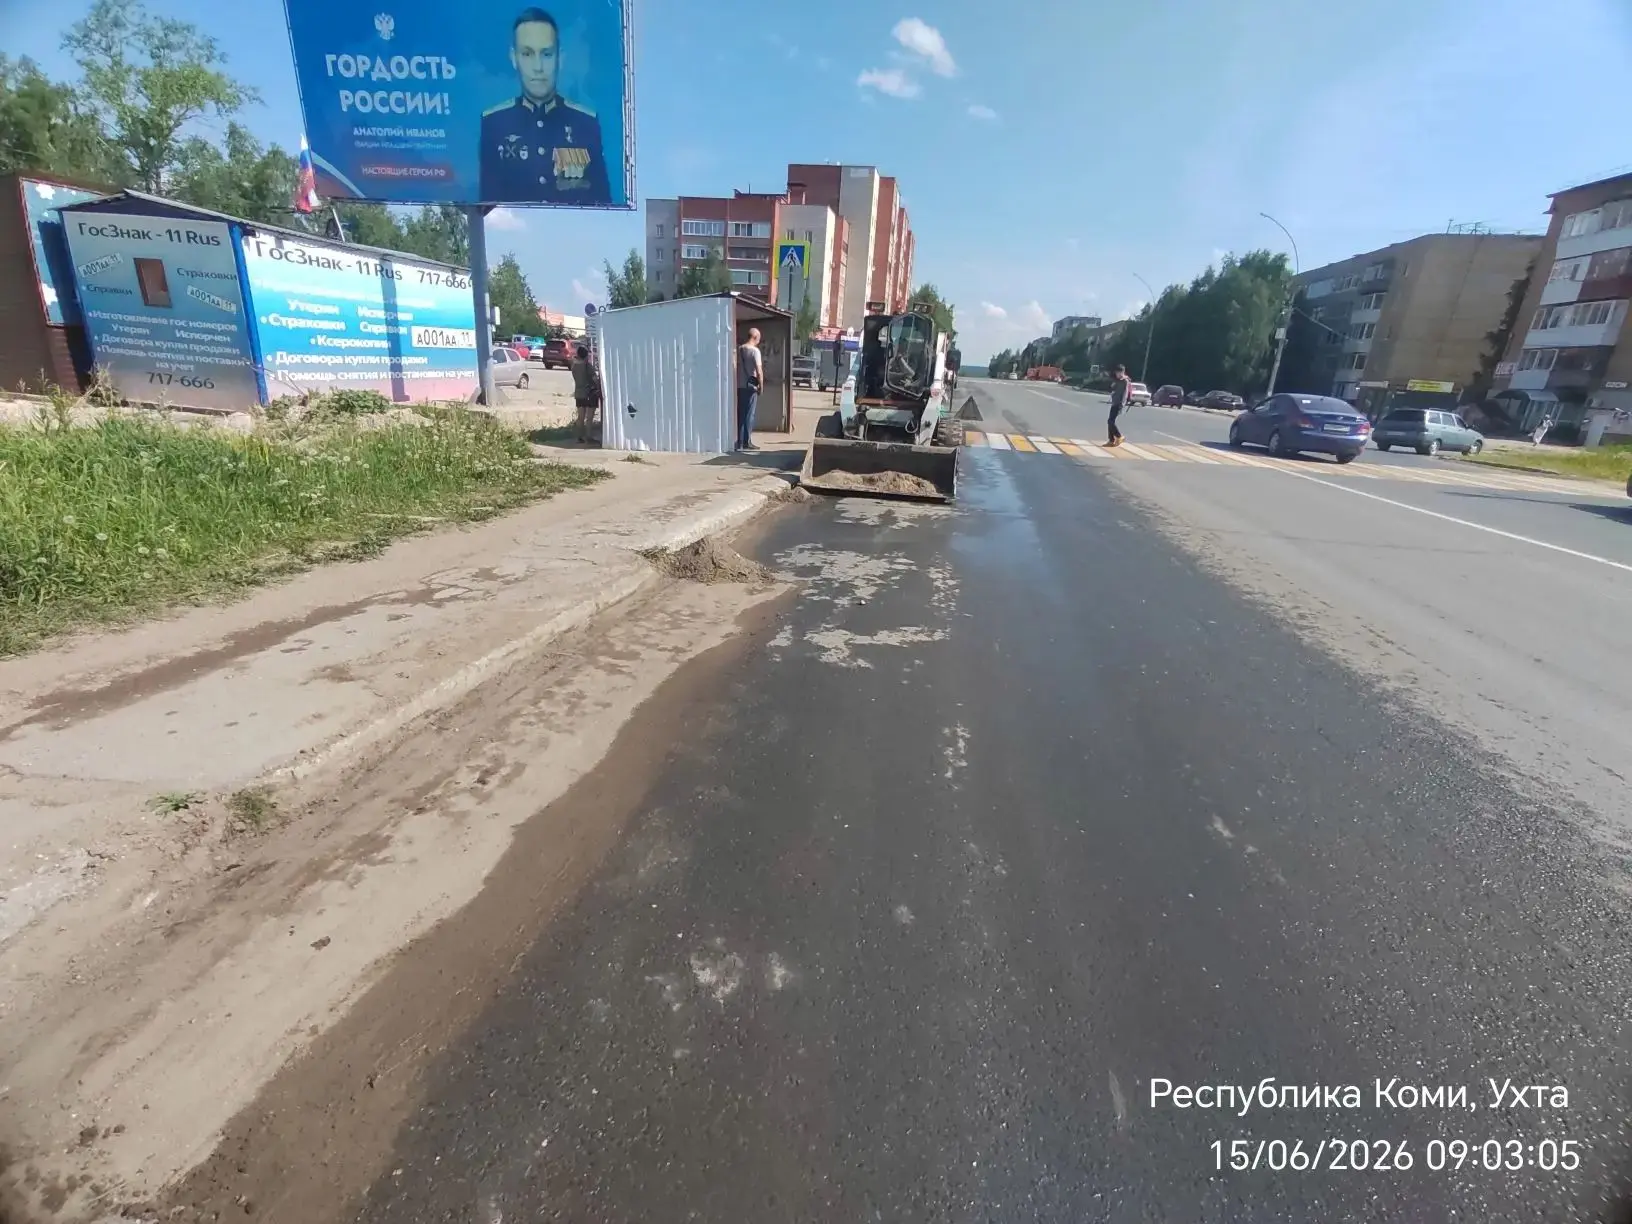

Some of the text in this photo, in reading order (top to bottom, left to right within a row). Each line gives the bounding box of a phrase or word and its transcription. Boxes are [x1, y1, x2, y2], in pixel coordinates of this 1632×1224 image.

[325, 54, 456, 81] ГОРДОСТЬ
[339, 90, 451, 115] РОССИИ!
[353, 126, 445, 138] АНАТОЛИЙ ИВАНОВ
[78, 222, 152, 240] ГосЗнак
[165, 228, 182, 243] 11
[186, 230, 221, 246] Rus
[176, 267, 238, 281] Страховки
[255, 240, 343, 272] ГосЗнак
[355, 260, 371, 276] 11
[374, 263, 403, 281] Rus
[416, 270, 467, 290] 717-666
[86, 284, 133, 296] Справки
[189, 320, 237, 332] номеров
[268, 313, 346, 332] Страховки
[111, 323, 231, 343] Утерян Испорчен
[416, 329, 457, 347] А001АА
[102, 333, 240, 355] Договора купли продажи
[275, 351, 428, 366] Договора купли продажи
[147, 371, 215, 389] 717-666
[276, 369, 336, 382] Помощь
[337, 371, 378, 381] снятия
